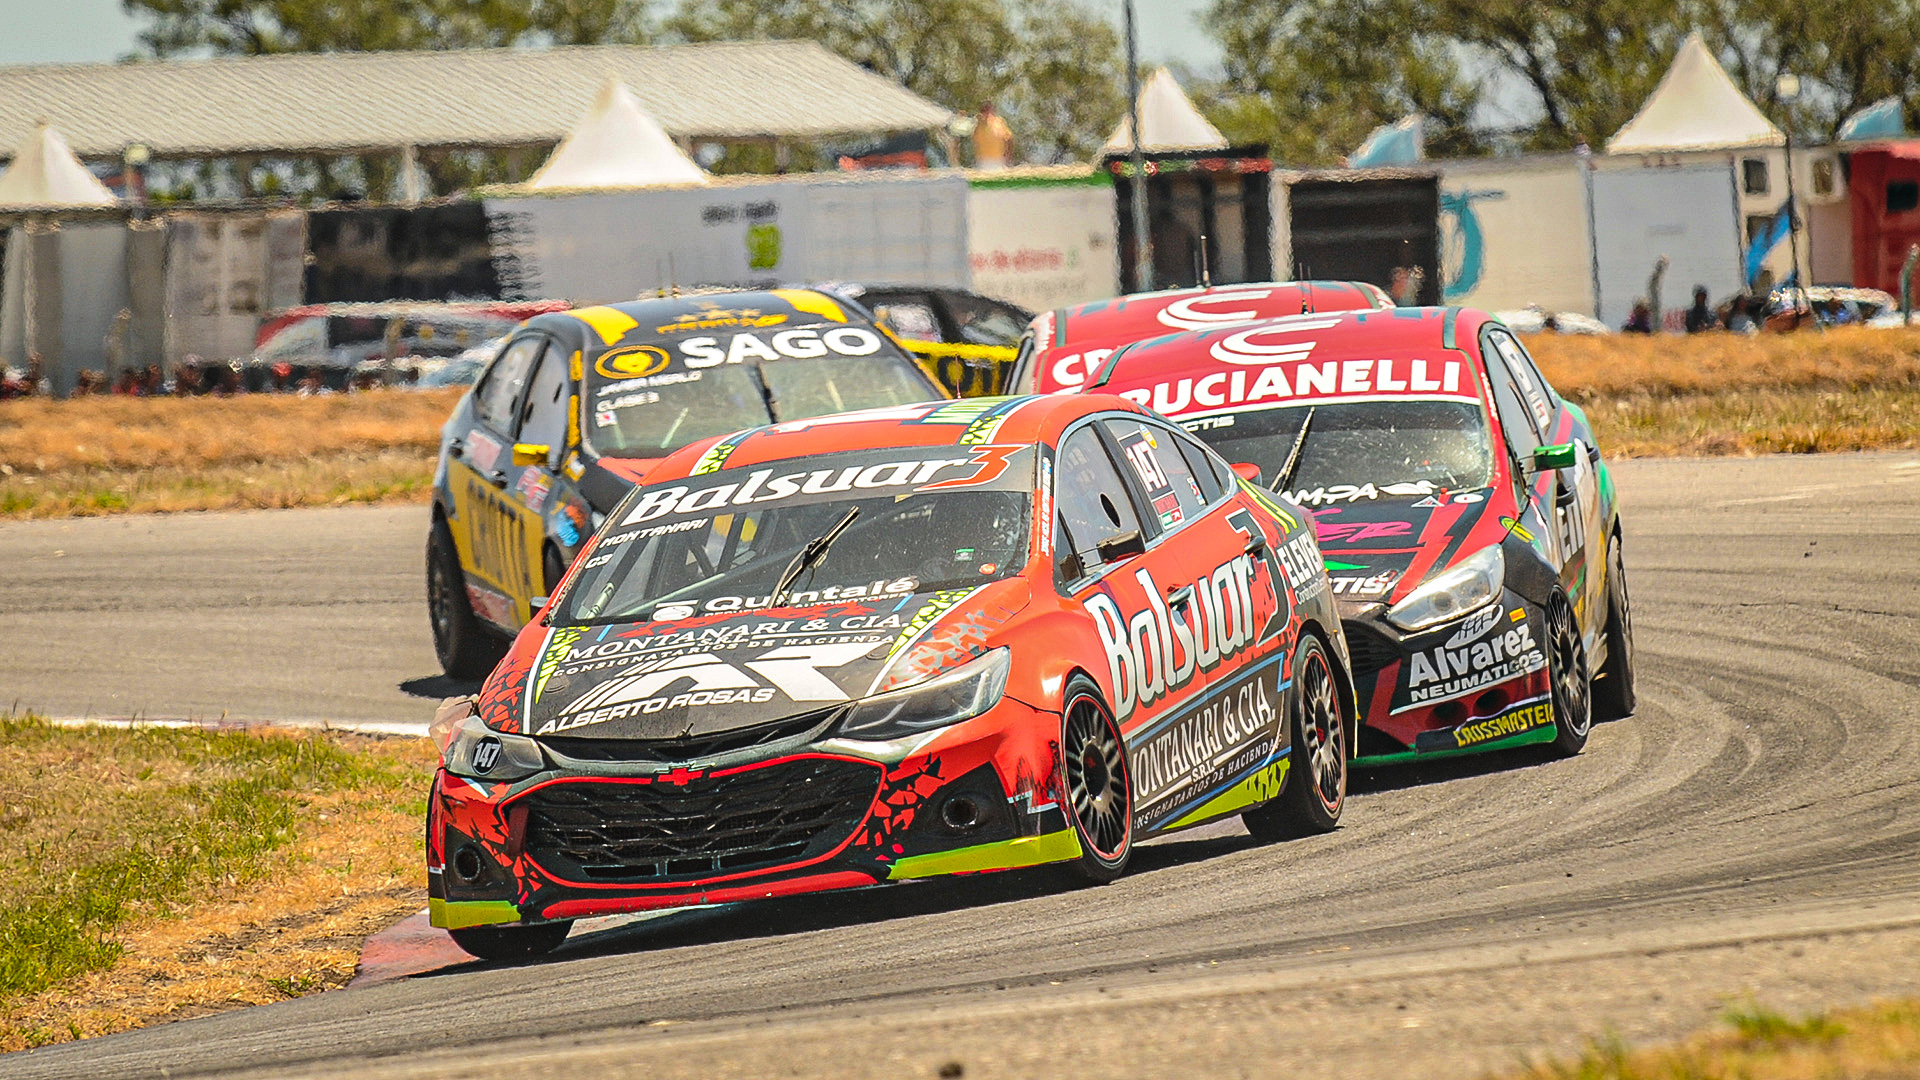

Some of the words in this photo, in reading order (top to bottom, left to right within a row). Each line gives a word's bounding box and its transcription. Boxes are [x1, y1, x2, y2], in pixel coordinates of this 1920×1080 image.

[678, 328, 881, 369] SAGO
[1179, 415, 1235, 432] CTIS
[599, 518, 709, 549] MONTANARI
[554, 643, 738, 677] CONSIGNATARIOS
[747, 639, 776, 648] DE
[784, 635, 895, 646] HACIENDA
[562, 620, 796, 663] MONTANARI
[800, 618, 830, 631] &
[840, 614, 910, 630] CIA.
[1082, 553, 1256, 723] Balsuar
[1409, 623, 1536, 688] Alvarez
[1410, 649, 1543, 703] NEUMATICOS
[536, 697, 668, 736] ALBERTO
[667, 687, 777, 710] ROSAS
[1222, 696, 1240, 745] &
[1238, 676, 1276, 736] CIA.
[473, 741, 502, 768] 147
